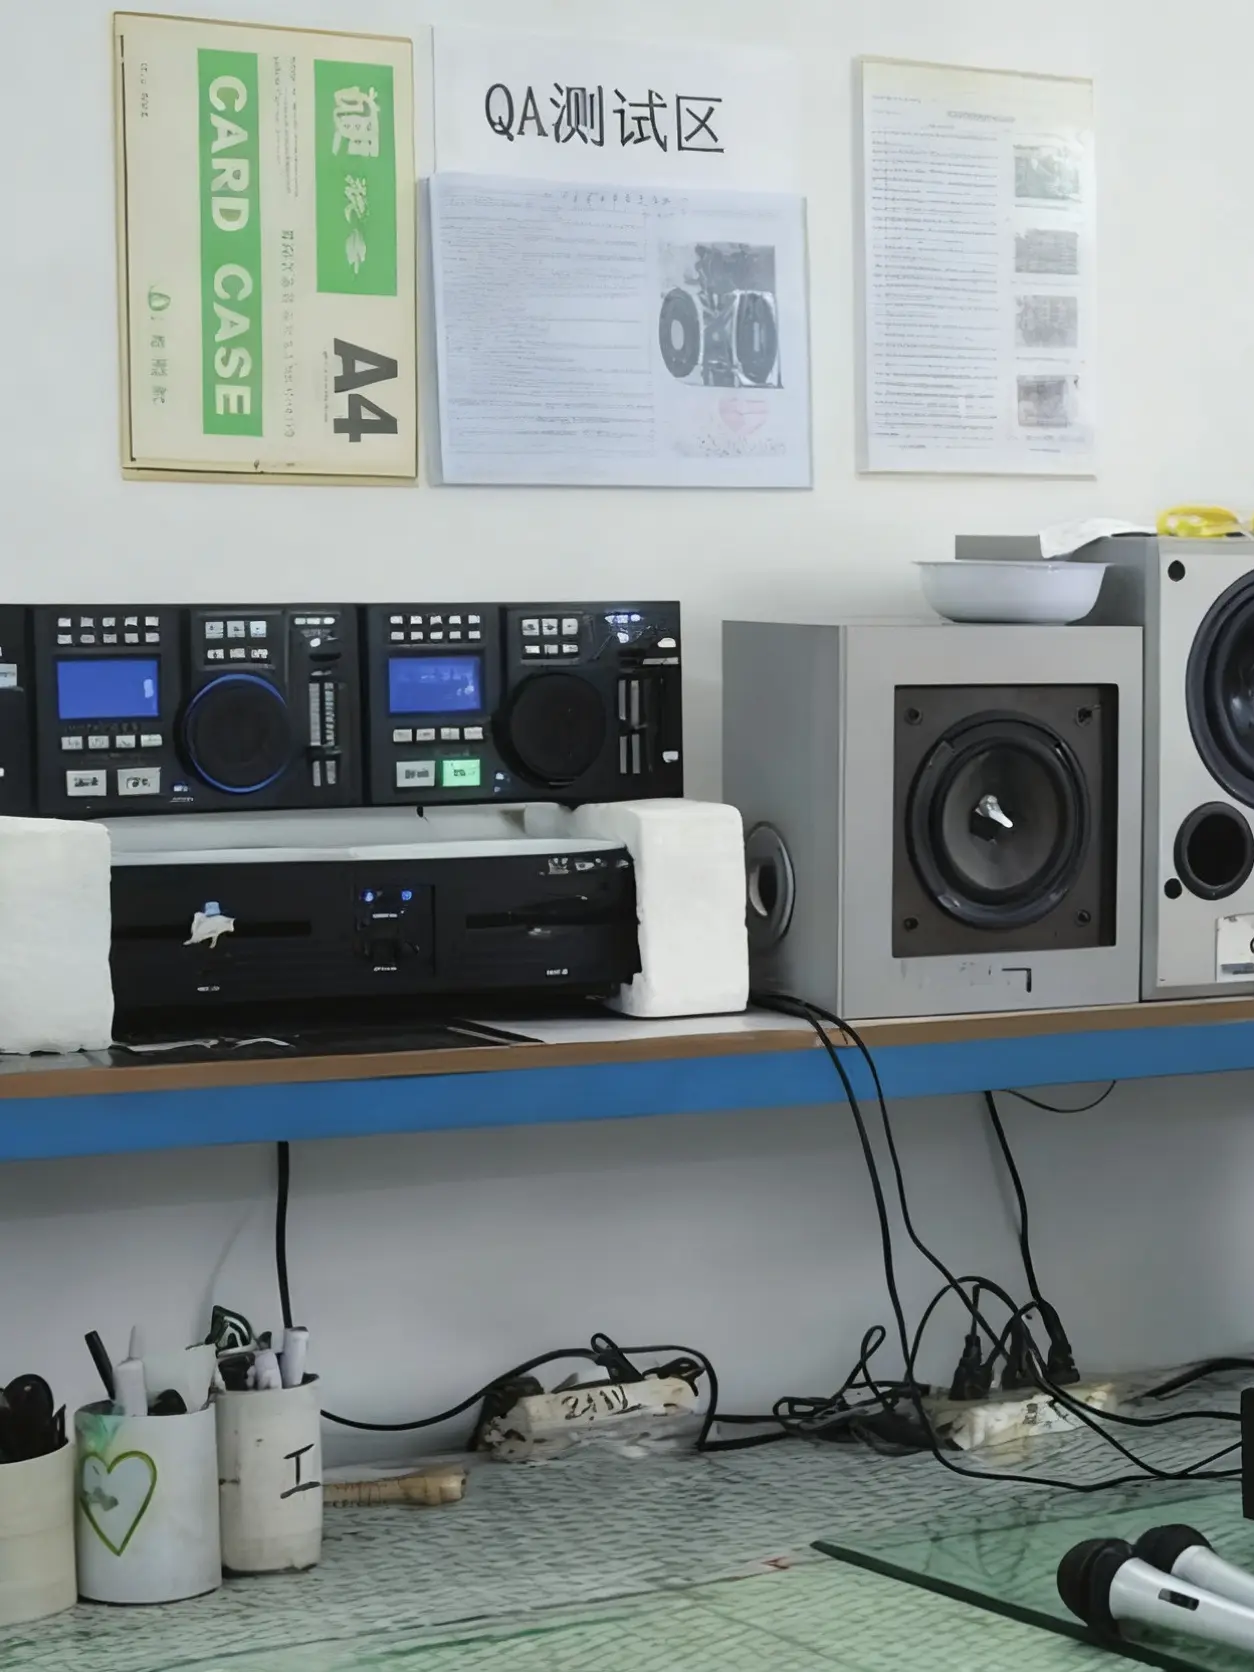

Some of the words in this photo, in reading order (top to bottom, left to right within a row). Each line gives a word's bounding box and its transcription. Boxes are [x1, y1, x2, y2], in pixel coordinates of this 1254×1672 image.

[208, 75, 250, 232] CARD
[484, 82, 725, 153] QA测试区
[213, 263, 253, 416] CASE
[333, 337, 398, 443] A4
